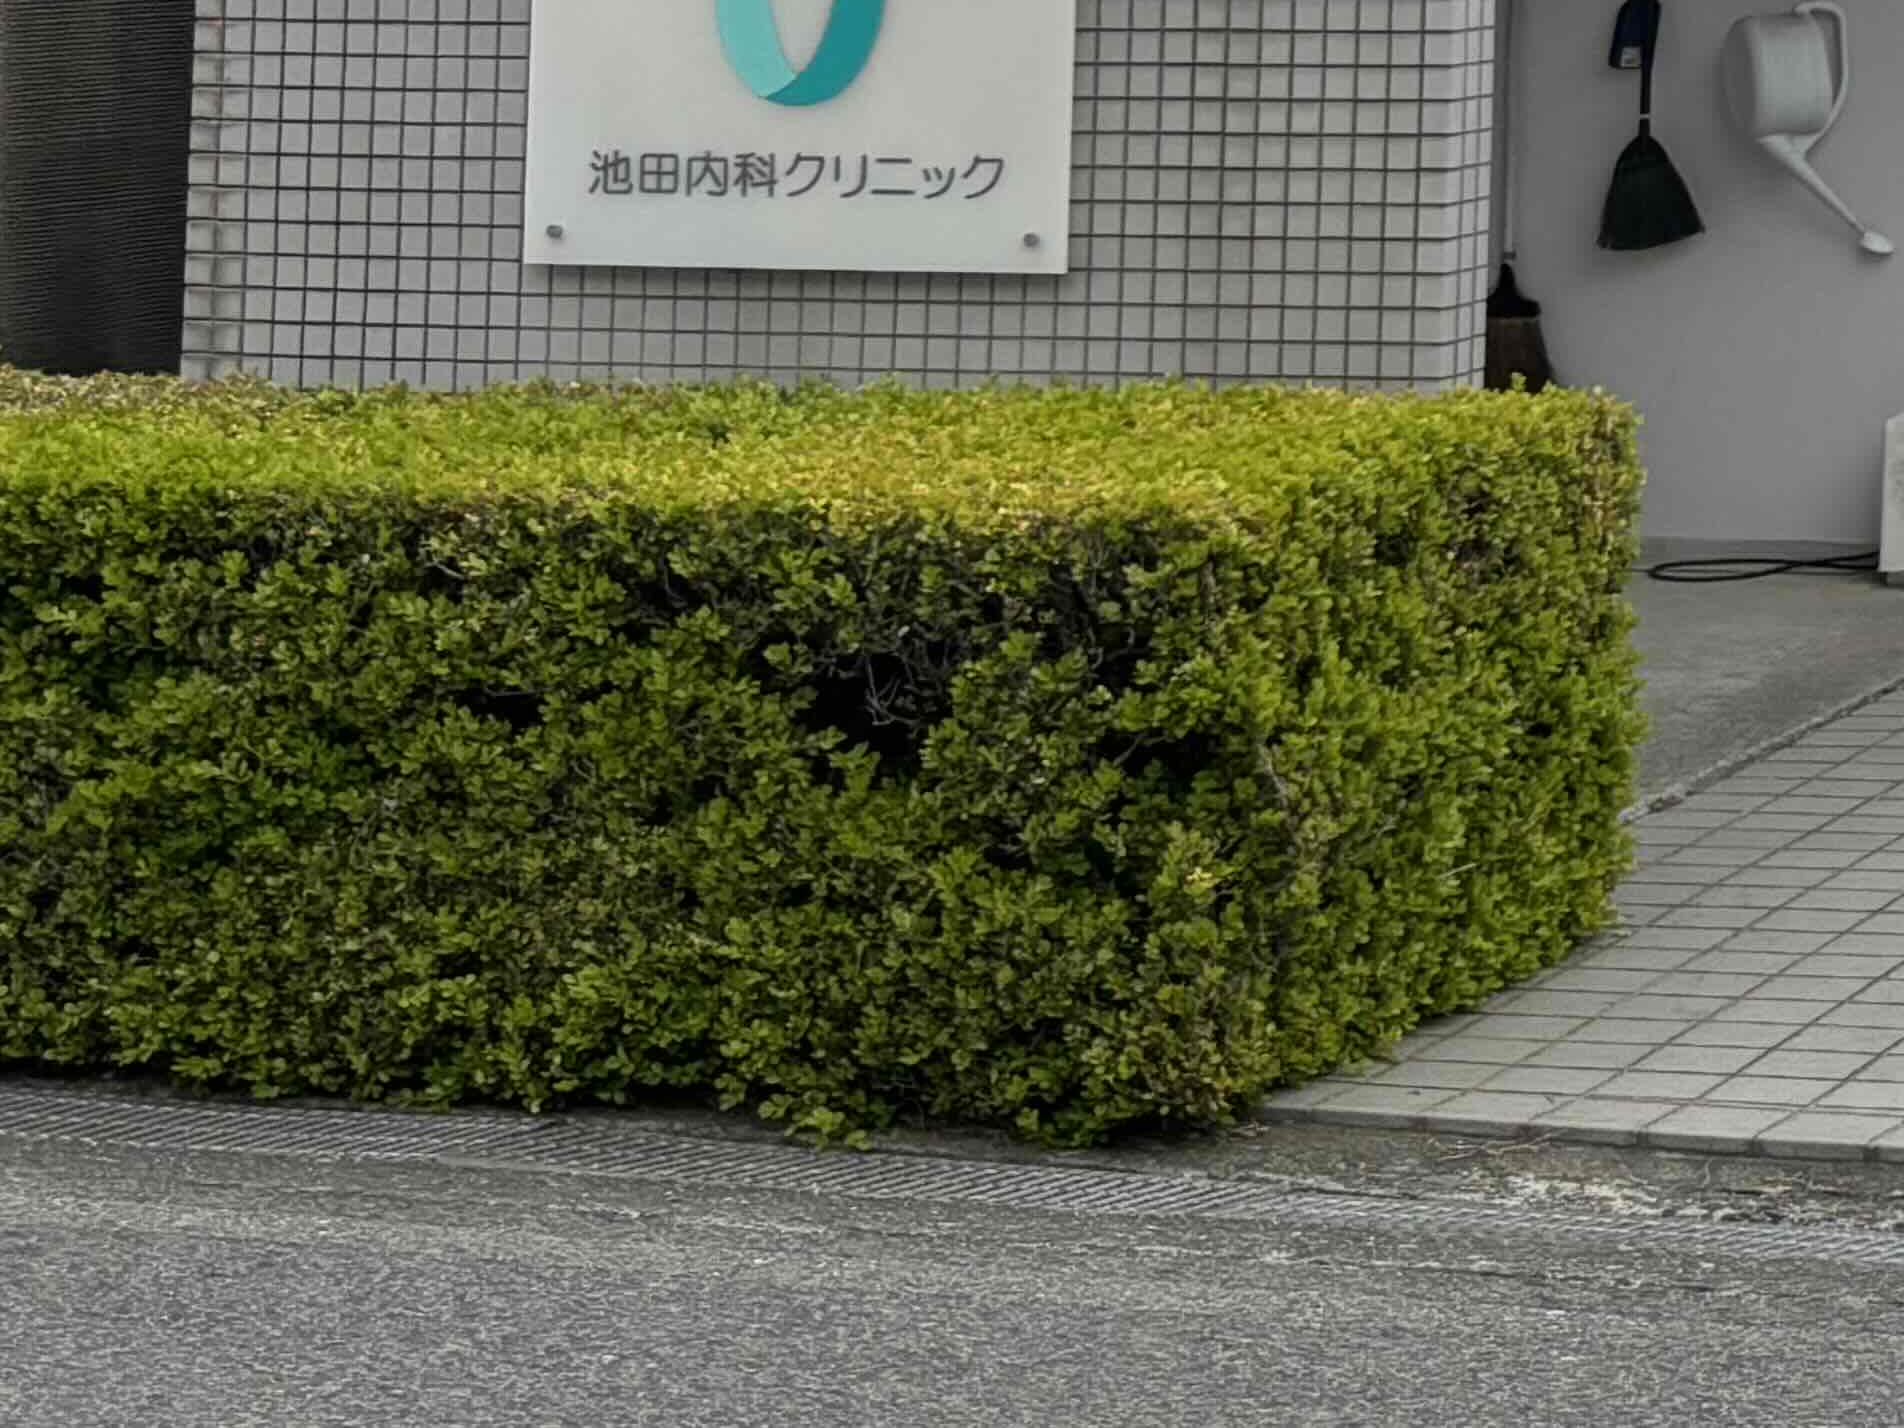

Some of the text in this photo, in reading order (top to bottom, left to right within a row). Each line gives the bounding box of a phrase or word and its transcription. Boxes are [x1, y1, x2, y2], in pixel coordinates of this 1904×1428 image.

[588, 149, 1004, 200] 池田内科クリニック
